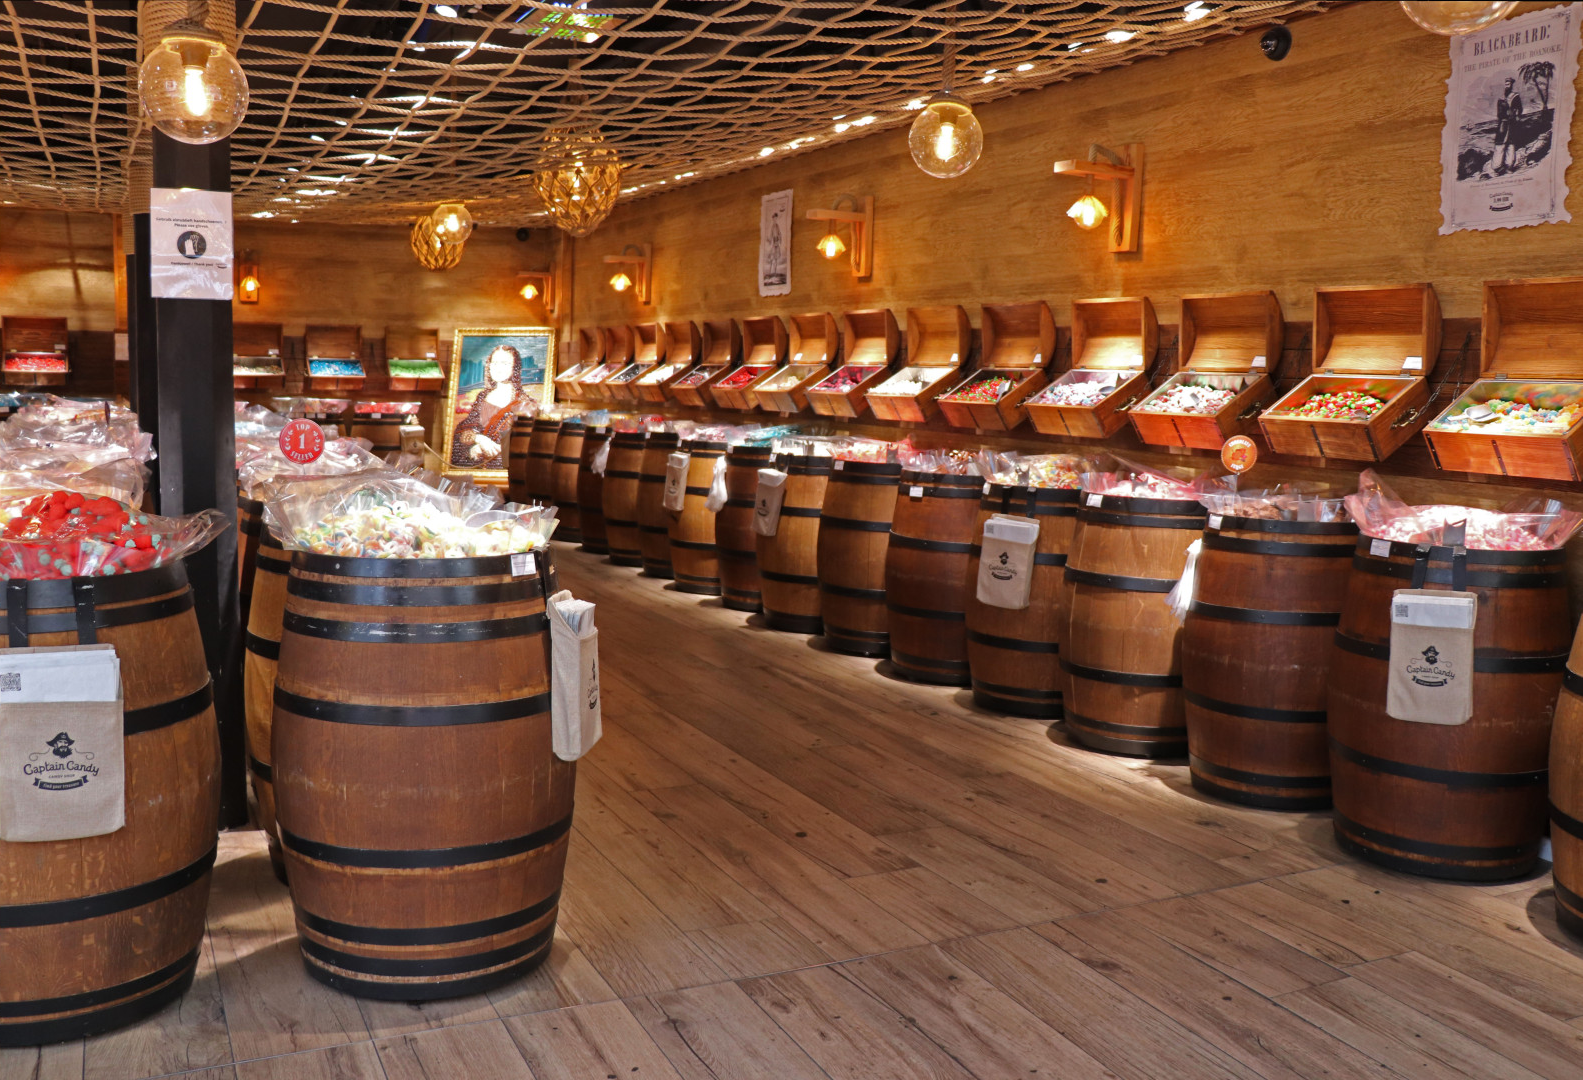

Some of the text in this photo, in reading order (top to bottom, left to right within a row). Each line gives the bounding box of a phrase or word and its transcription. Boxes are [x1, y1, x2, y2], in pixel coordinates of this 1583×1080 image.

[1474, 24, 1551, 56] BLACKBEARD:
[1464, 63, 1476, 73] THE
[1478, 58, 1500, 70] PIRATE
[1502, 56, 1510, 64] OF
[1513, 51, 1526, 61] THE
[299, 433, 305, 449] 1
[290, 450, 314, 460] SELLER
[1407, 665, 1455, 680] Captain Candy
[23, 760, 100, 777] Captain Candy
